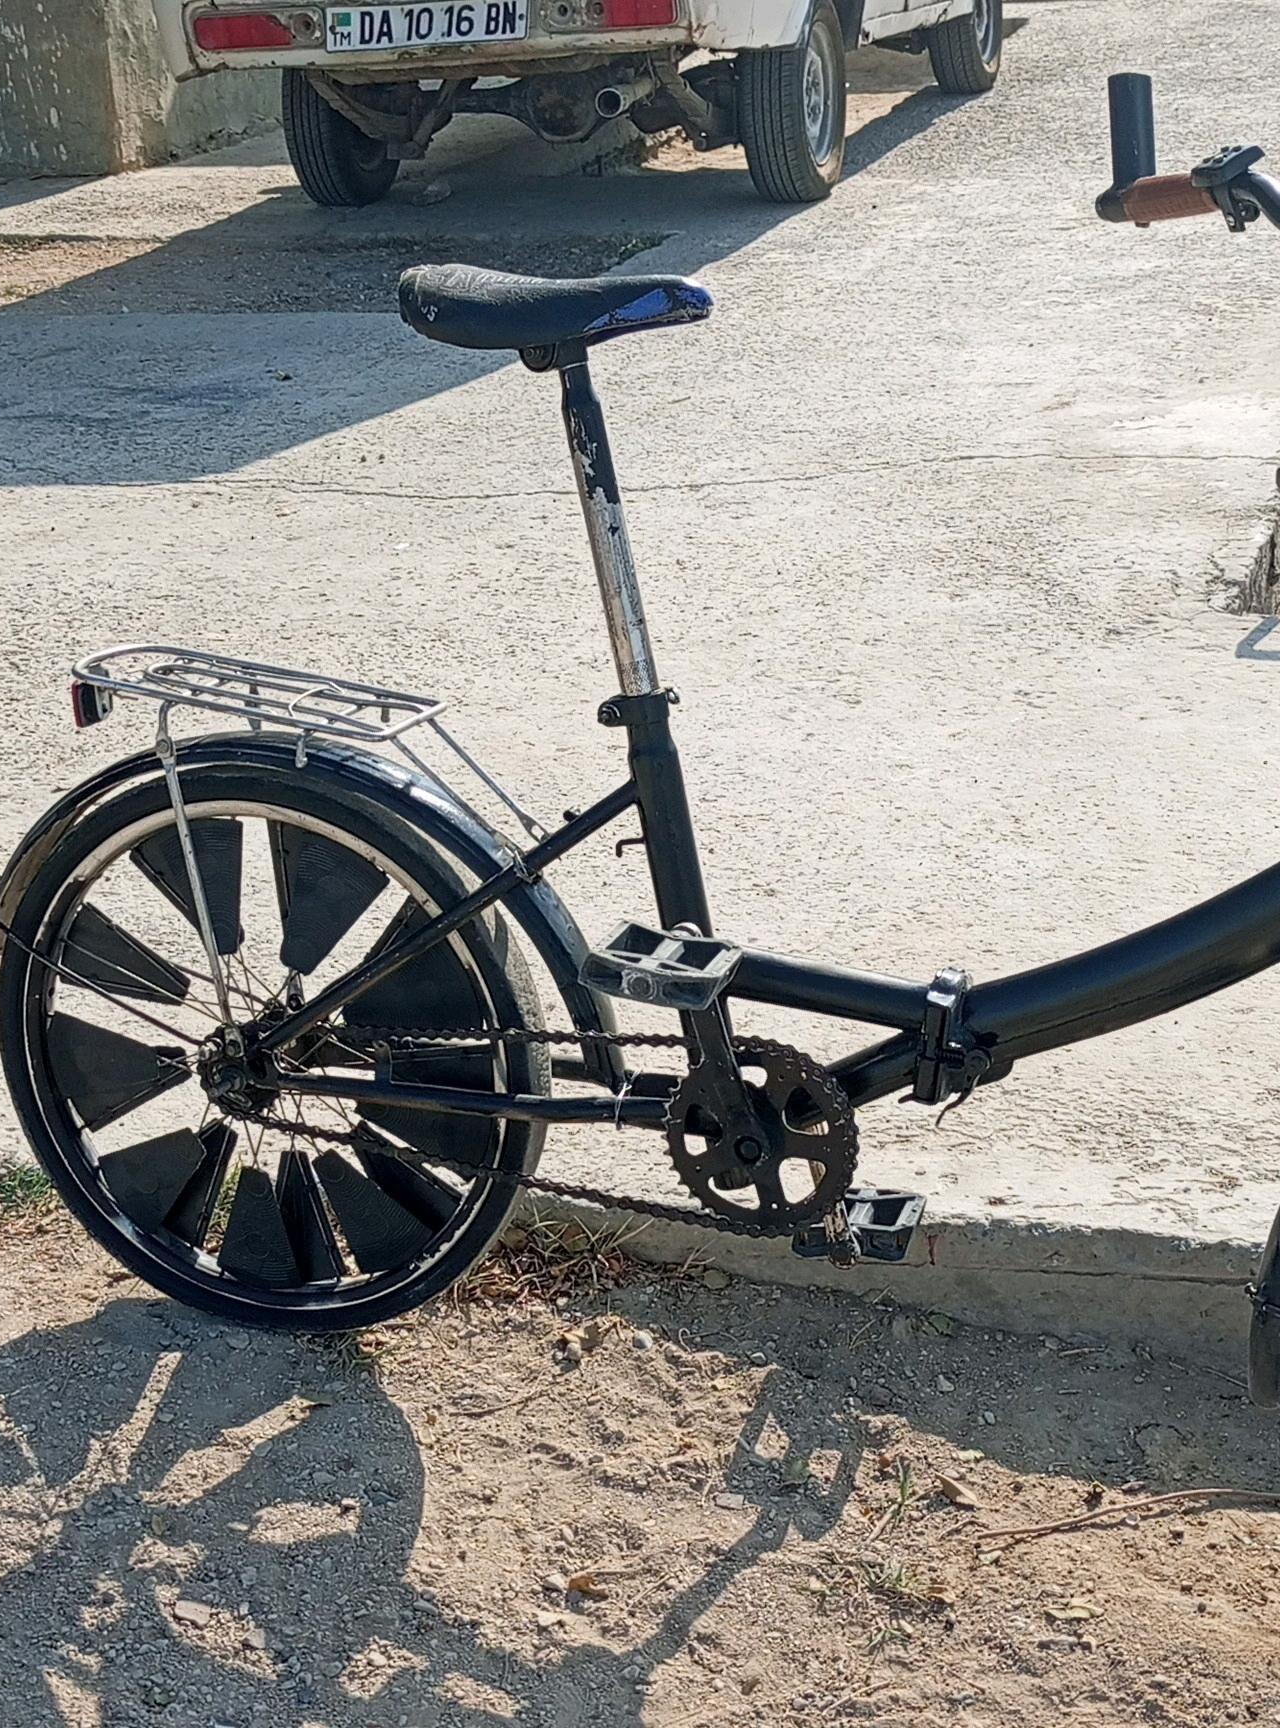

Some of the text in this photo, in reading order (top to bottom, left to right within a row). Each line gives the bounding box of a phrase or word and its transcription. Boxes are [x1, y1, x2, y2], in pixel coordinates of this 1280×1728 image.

[359, 1, 517, 45] DA 10 16 BN
[333, 31, 352, 48] TM
